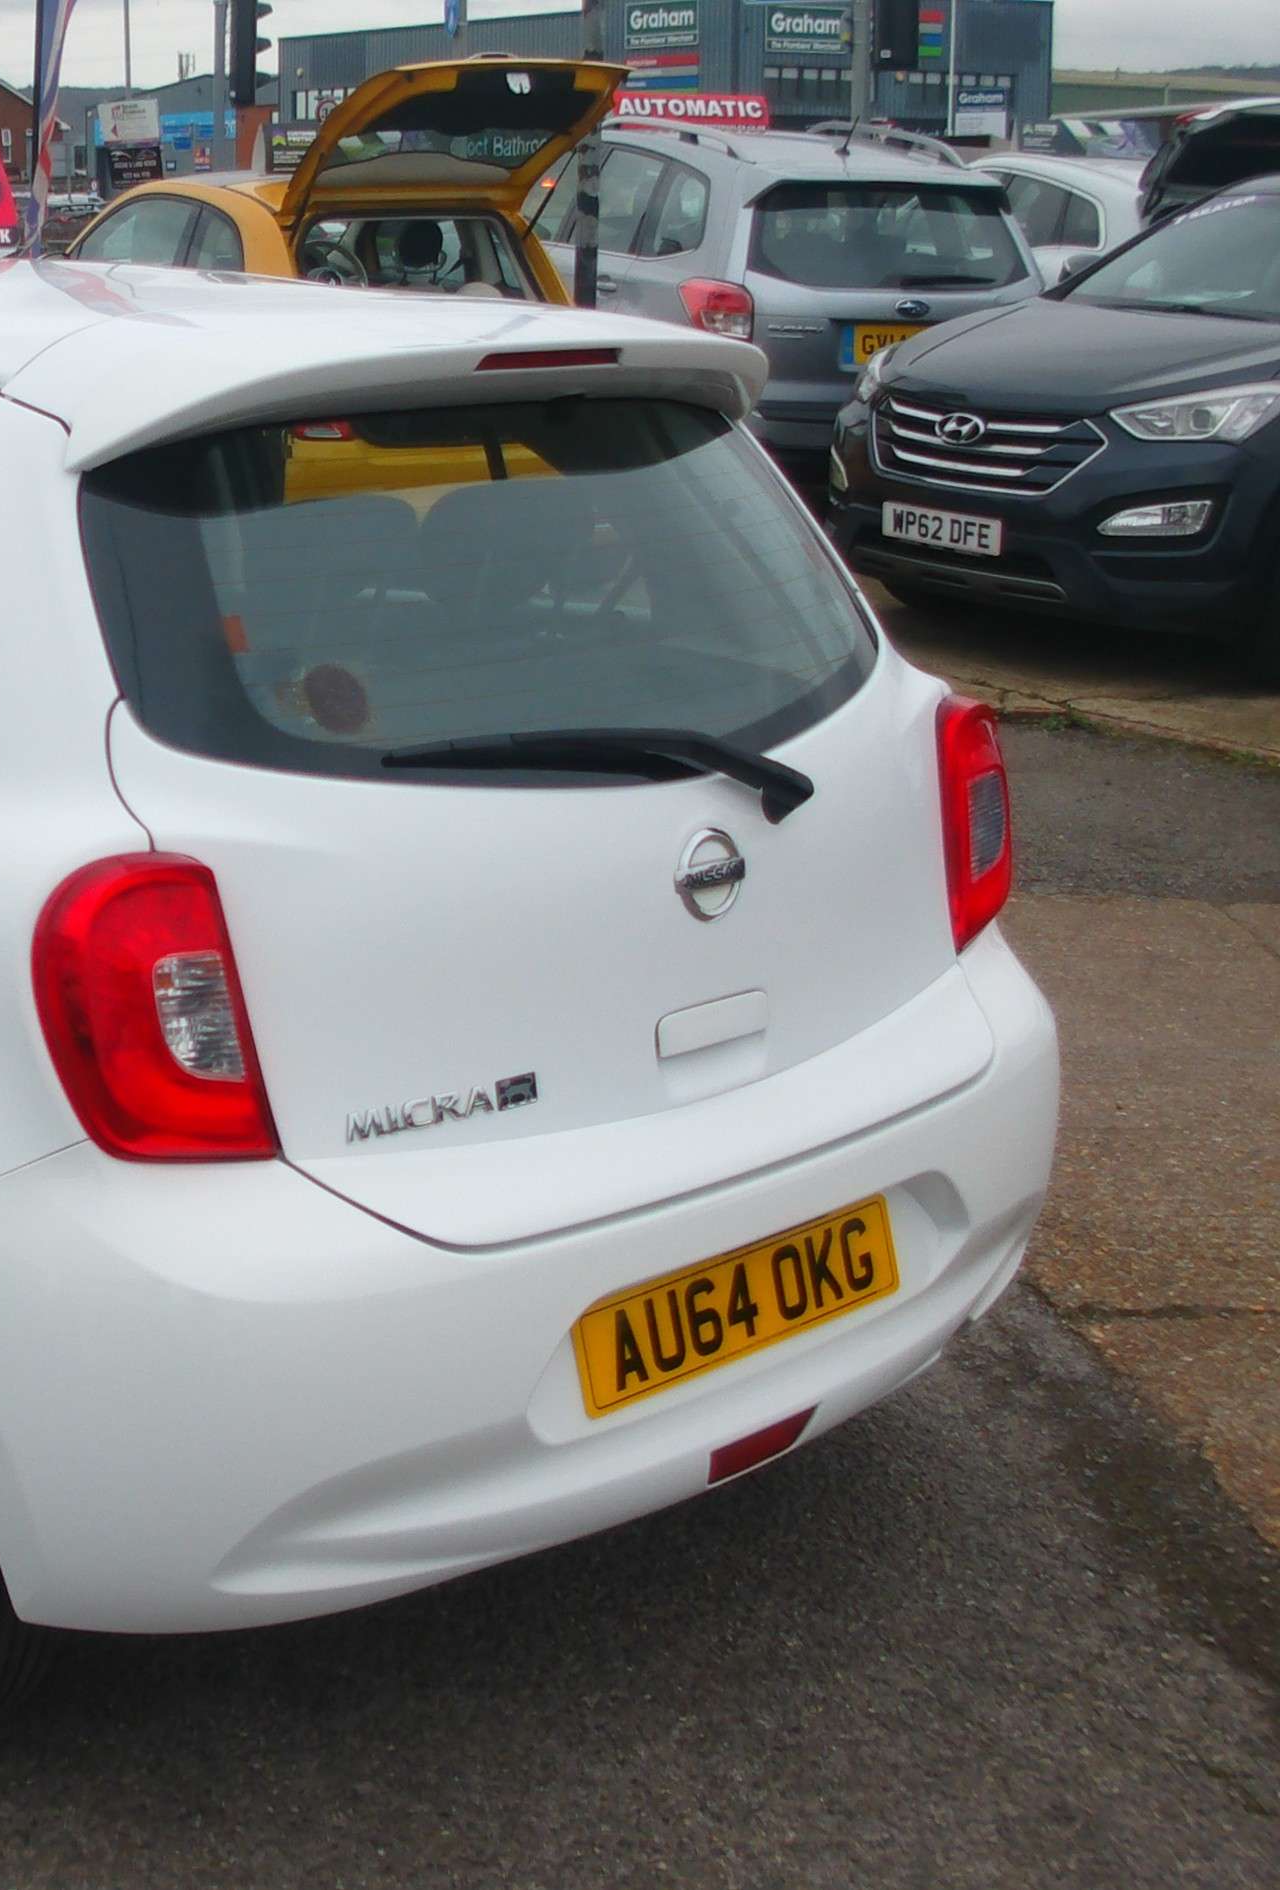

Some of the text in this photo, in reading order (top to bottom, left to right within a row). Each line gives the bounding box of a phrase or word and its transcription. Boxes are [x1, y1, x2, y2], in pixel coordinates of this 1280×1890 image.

[630, 9, 694, 30] Graham
[771, 11, 841, 34] Graham
[619, 97, 763, 118] AUTOMATIC
[893, 508, 990, 550] WP62 DFE
[346, 1086, 494, 1144] MICRA
[615, 1217, 874, 1392] AU64 OKG
